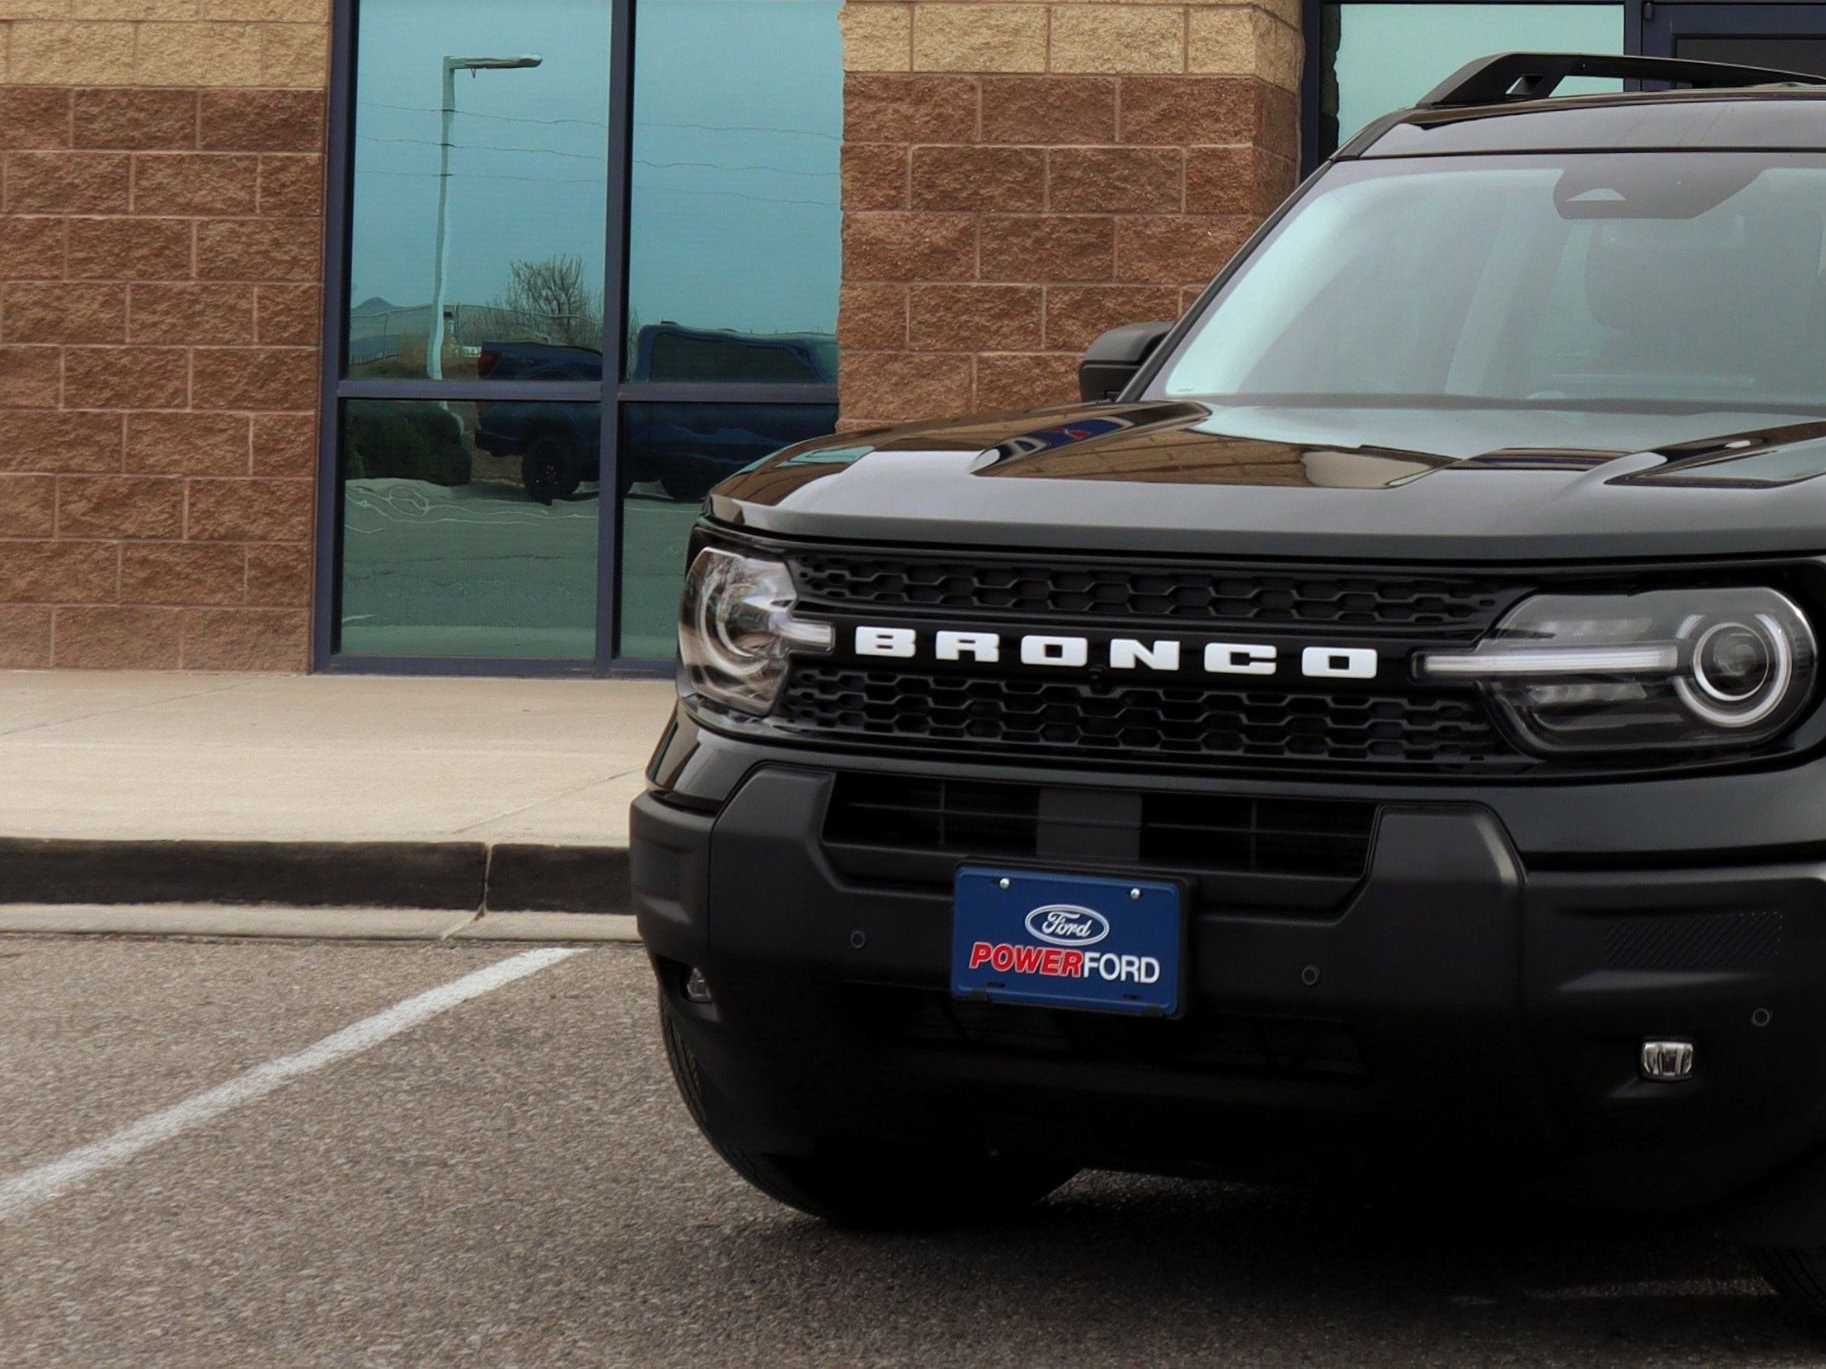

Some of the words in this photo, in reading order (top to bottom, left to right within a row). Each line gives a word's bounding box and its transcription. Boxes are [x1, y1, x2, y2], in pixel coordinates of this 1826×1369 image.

[855, 627, 1377, 678] BRONCO
[1042, 912, 1092, 937] Ford
[969, 942, 1160, 983] POWERFORD
